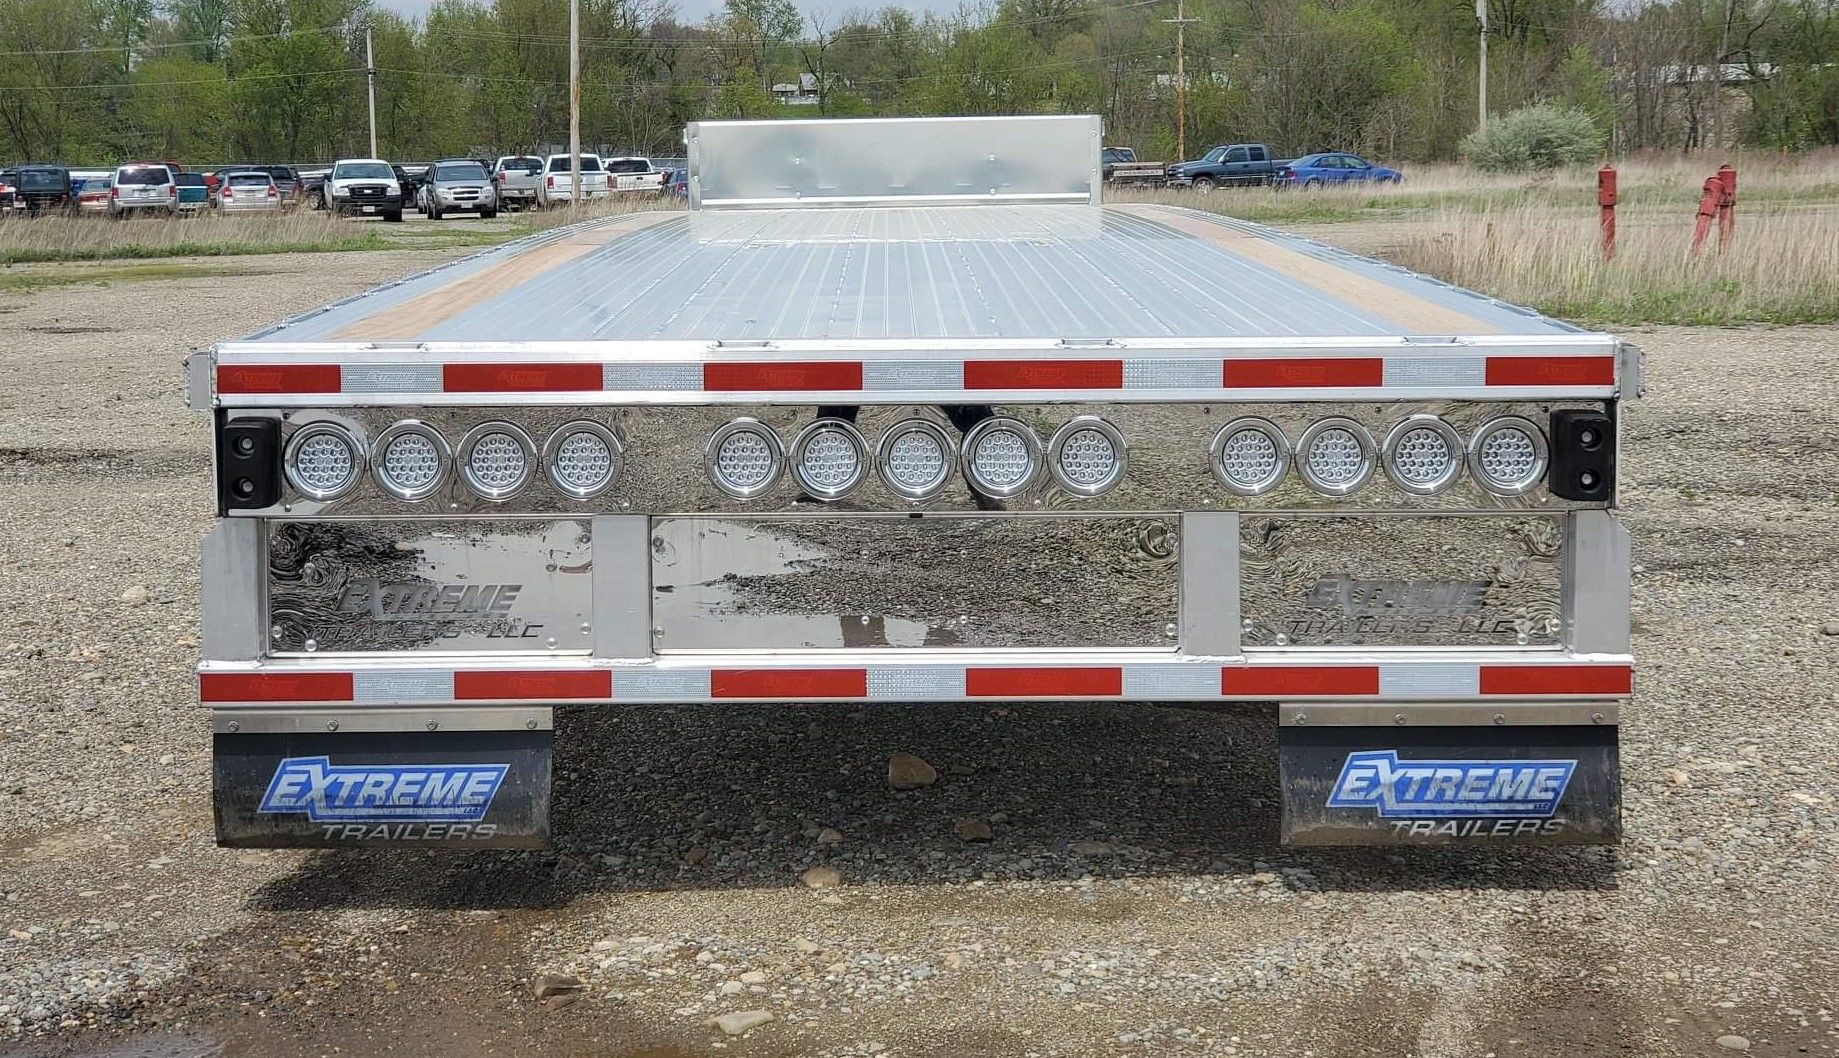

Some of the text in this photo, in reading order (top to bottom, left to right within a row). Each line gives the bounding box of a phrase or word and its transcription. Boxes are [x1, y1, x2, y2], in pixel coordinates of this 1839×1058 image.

[486, 624, 544, 638] LLC
[1456, 620, 1516, 634] LLC
[270, 765, 499, 813] EXTREME
[1338, 759, 1566, 810] EXTREME
[321, 823, 498, 841] TRAILERS
[1390, 818, 1567, 838] TRAILERS
